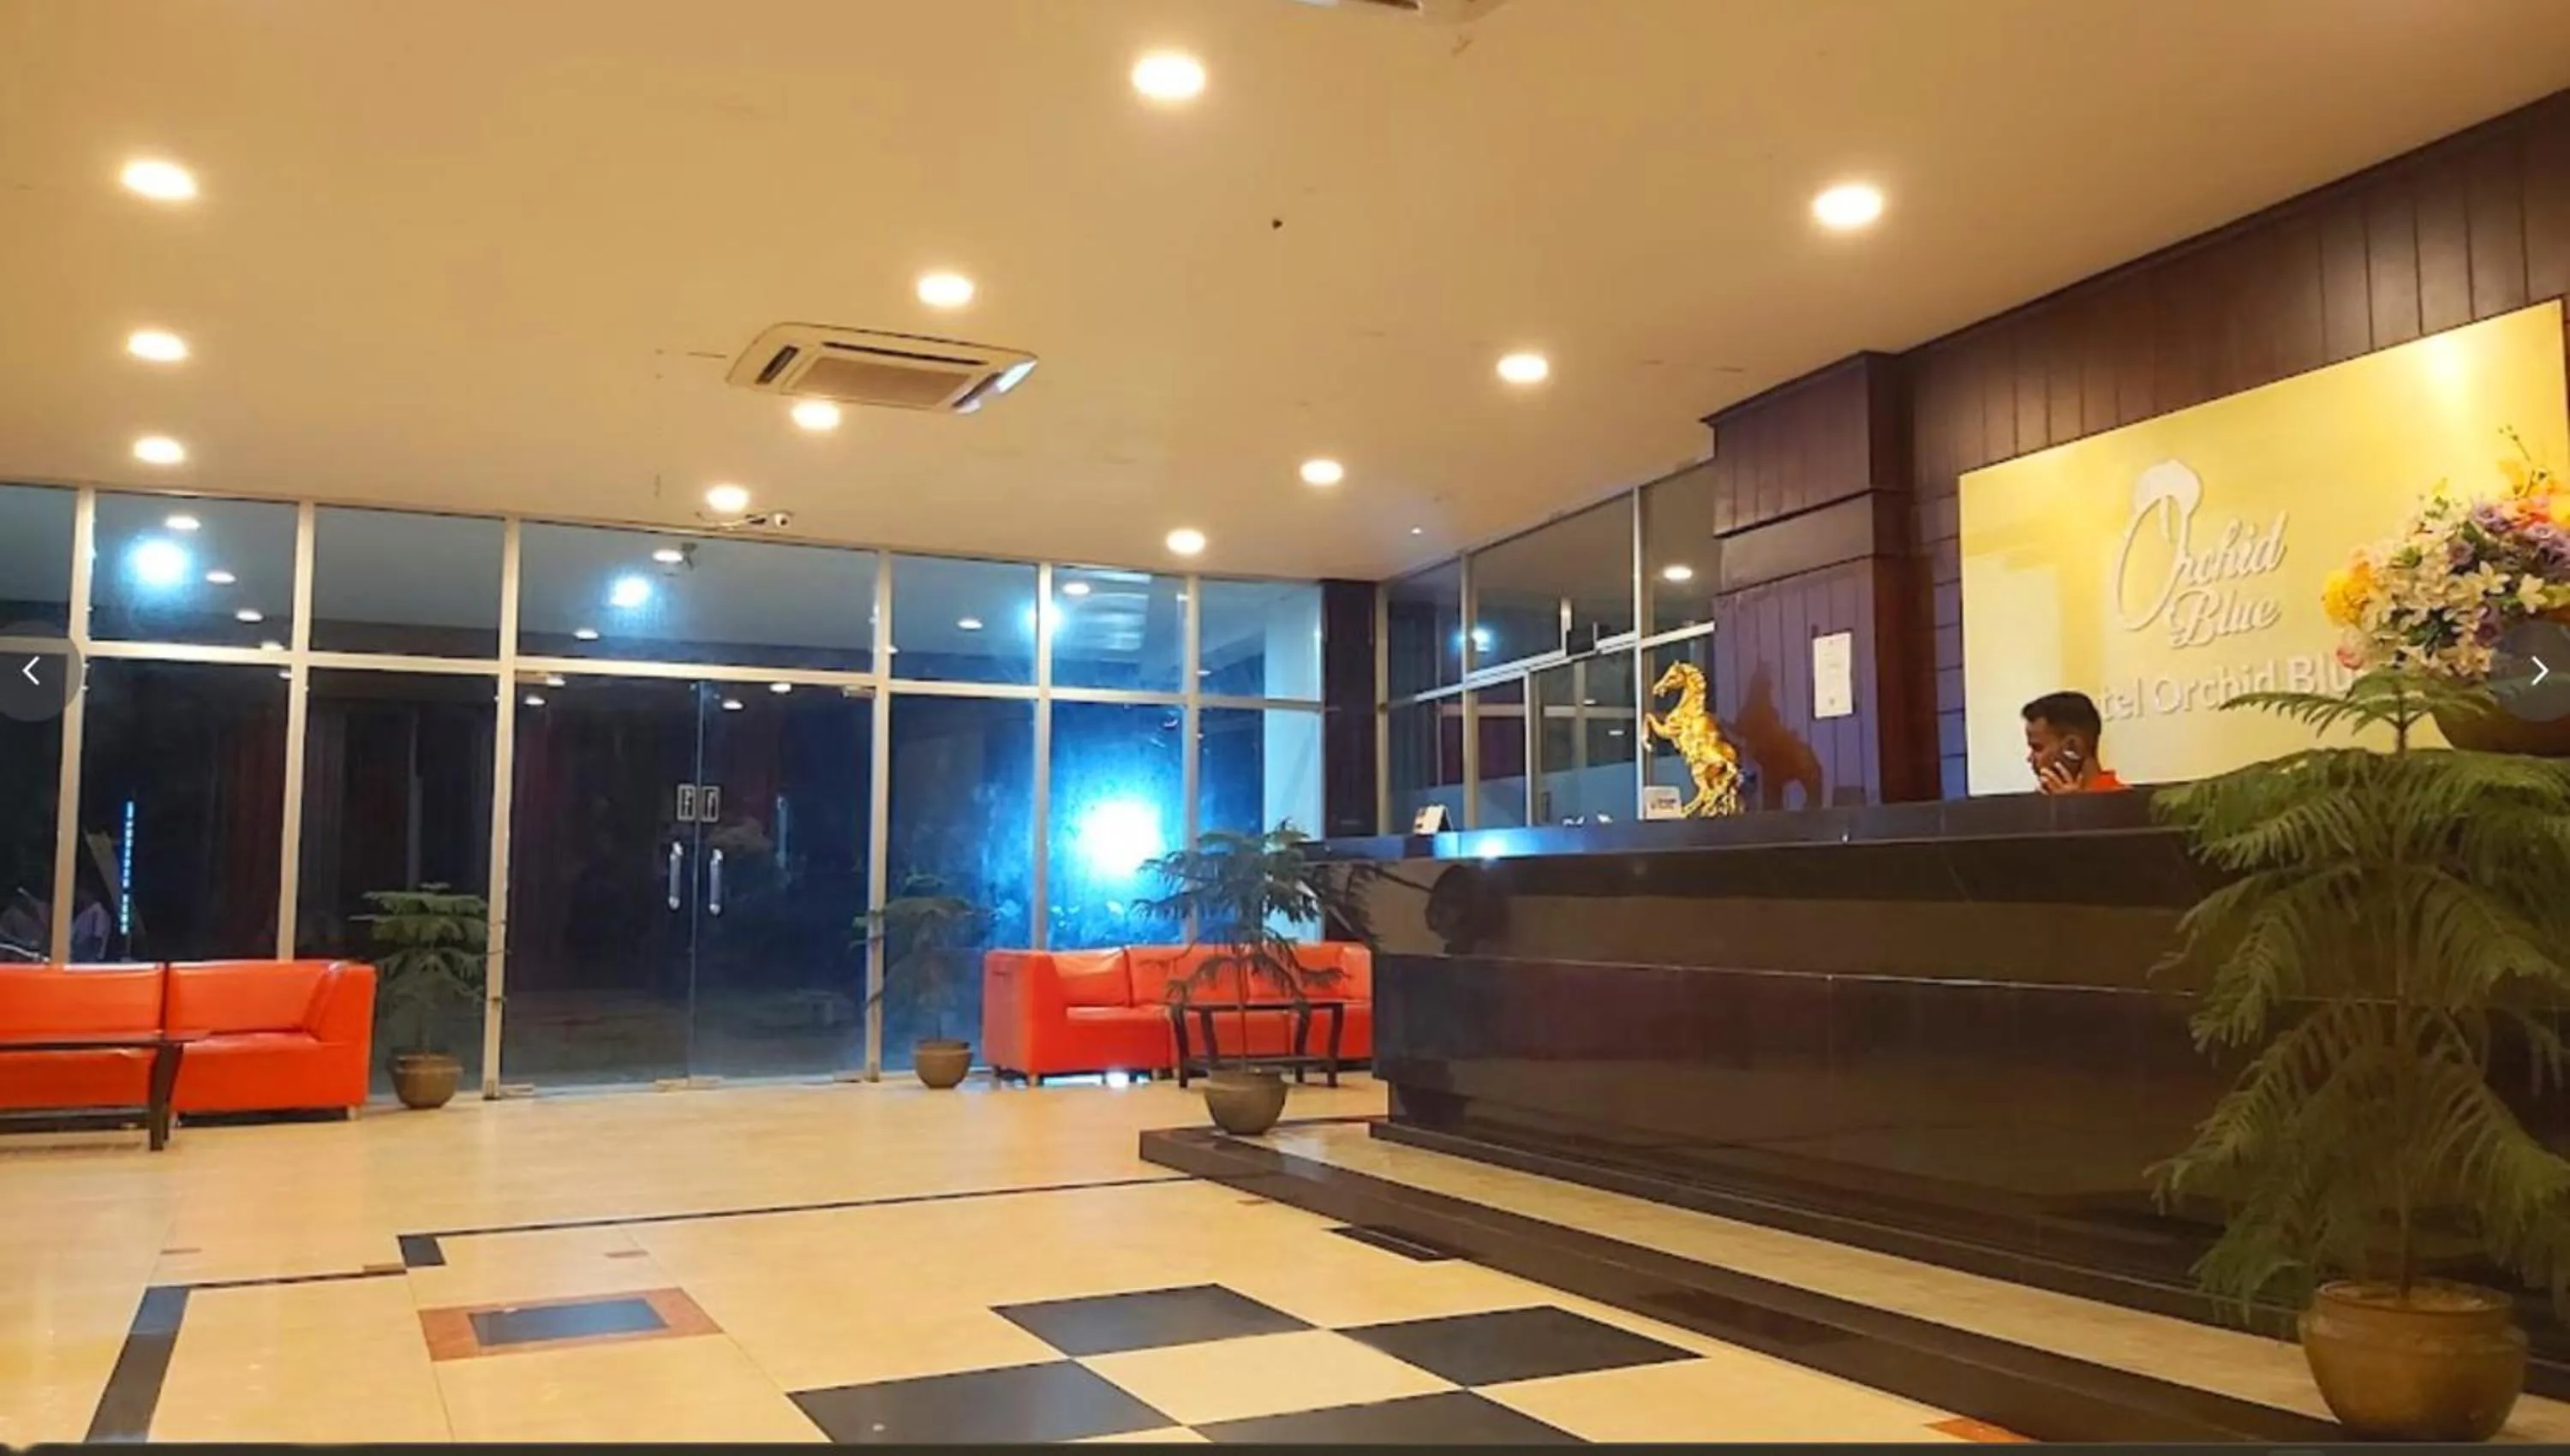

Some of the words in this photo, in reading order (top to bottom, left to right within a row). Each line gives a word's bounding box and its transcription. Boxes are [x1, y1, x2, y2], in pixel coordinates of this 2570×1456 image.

[2113, 462, 2290, 632] Orchid
[2164, 585, 2282, 650] Blue
[2097, 675, 2143, 722] tel
[2152, 656, 2275, 714] Orchid
[2287, 652, 2358, 697] Blu
